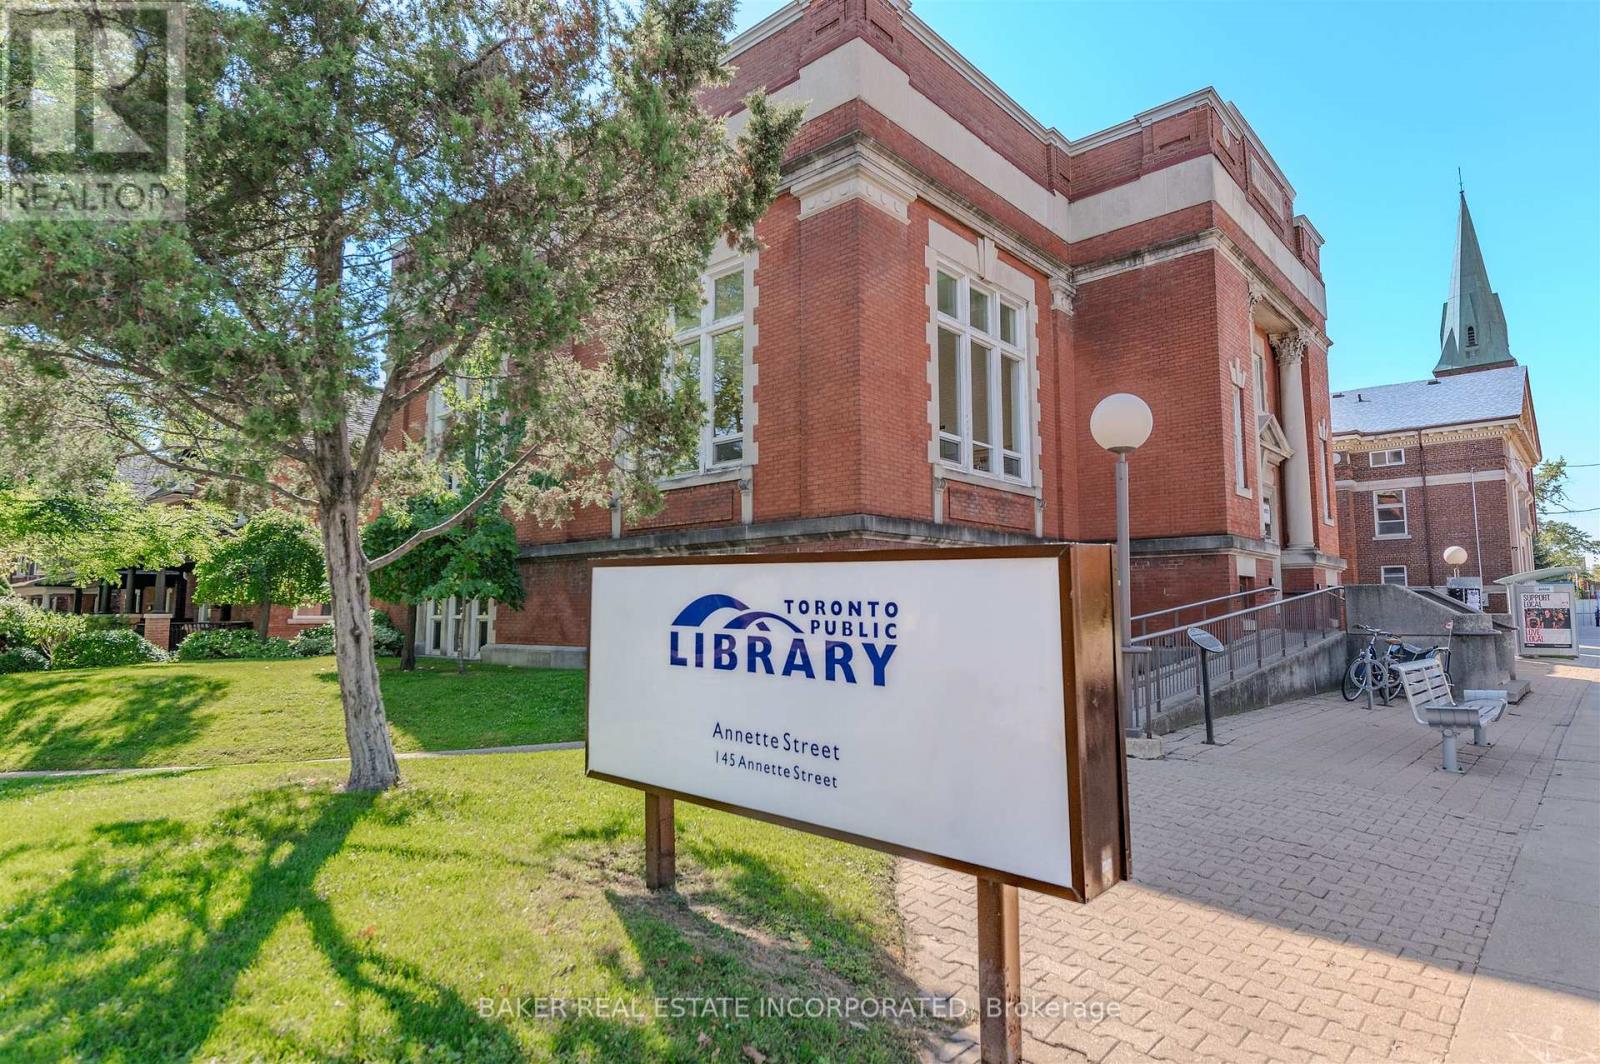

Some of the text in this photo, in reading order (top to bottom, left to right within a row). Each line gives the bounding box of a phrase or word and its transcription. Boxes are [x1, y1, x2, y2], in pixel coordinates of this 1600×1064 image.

[784, 600, 898, 618] TORONTO
[811, 620, 897, 639] PUBLIC
[670, 631, 897, 687] LIBRARY
[712, 722, 840, 761] Annette Street
[715, 751, 837, 788] 145 Annette Street
